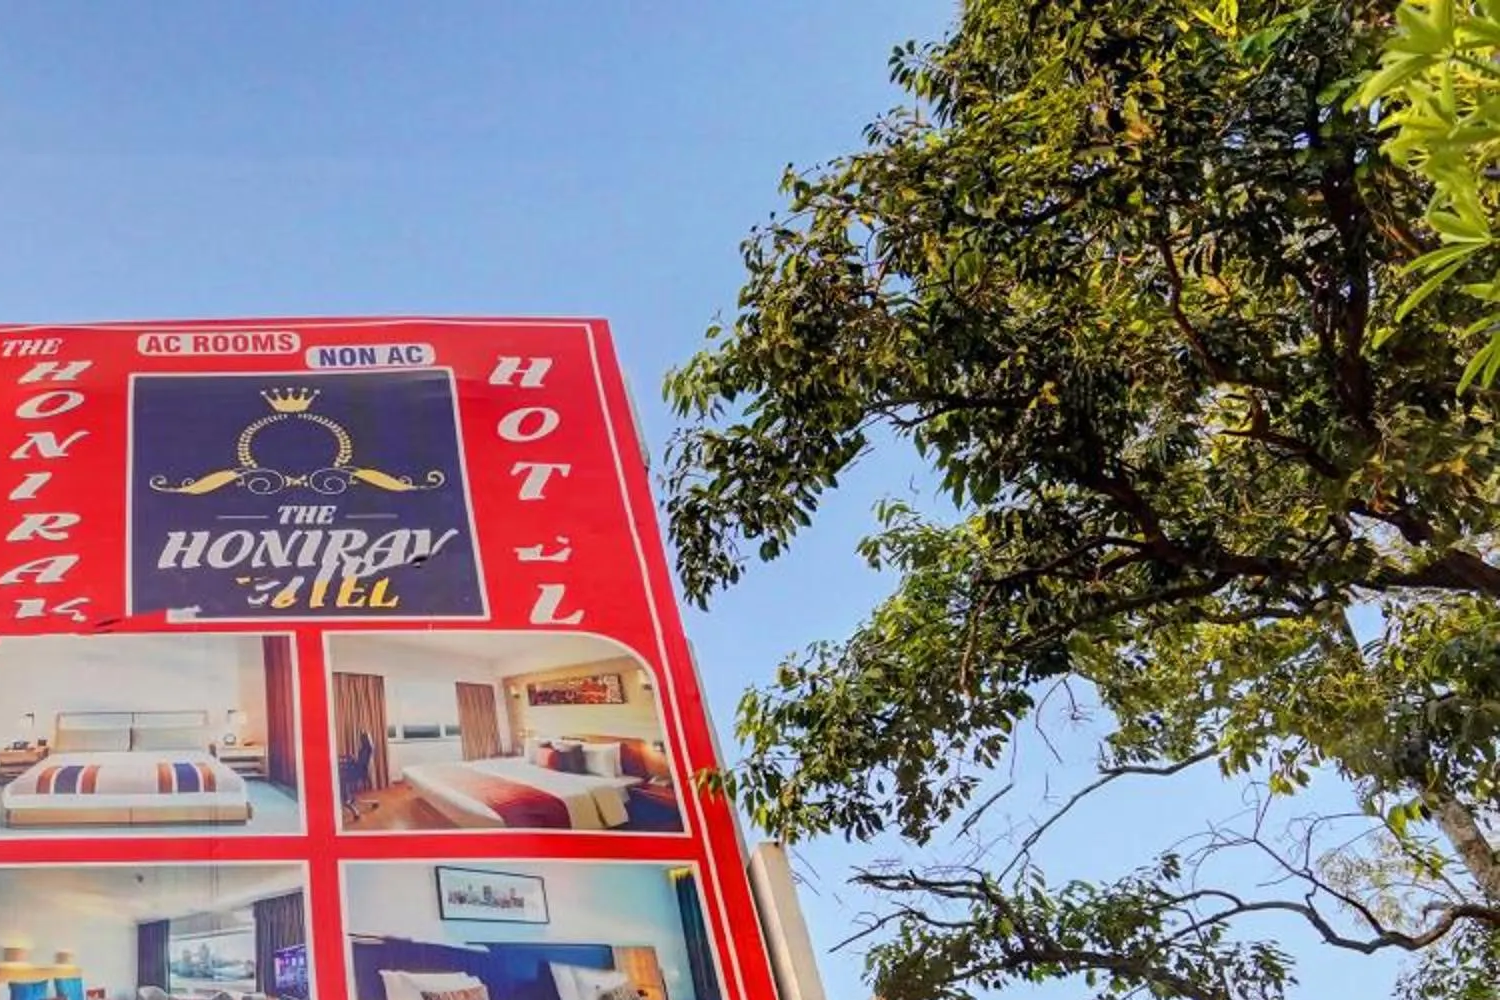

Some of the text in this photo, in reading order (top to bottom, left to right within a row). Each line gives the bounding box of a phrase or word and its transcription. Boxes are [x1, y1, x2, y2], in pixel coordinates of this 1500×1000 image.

[0, 337, 63, 357] THE
[144, 332, 294, 354] AC ROOMS
[317, 344, 425, 366] NON AC
[276, 504, 337, 526] THE
[156, 528, 460, 575] HONIRAV
